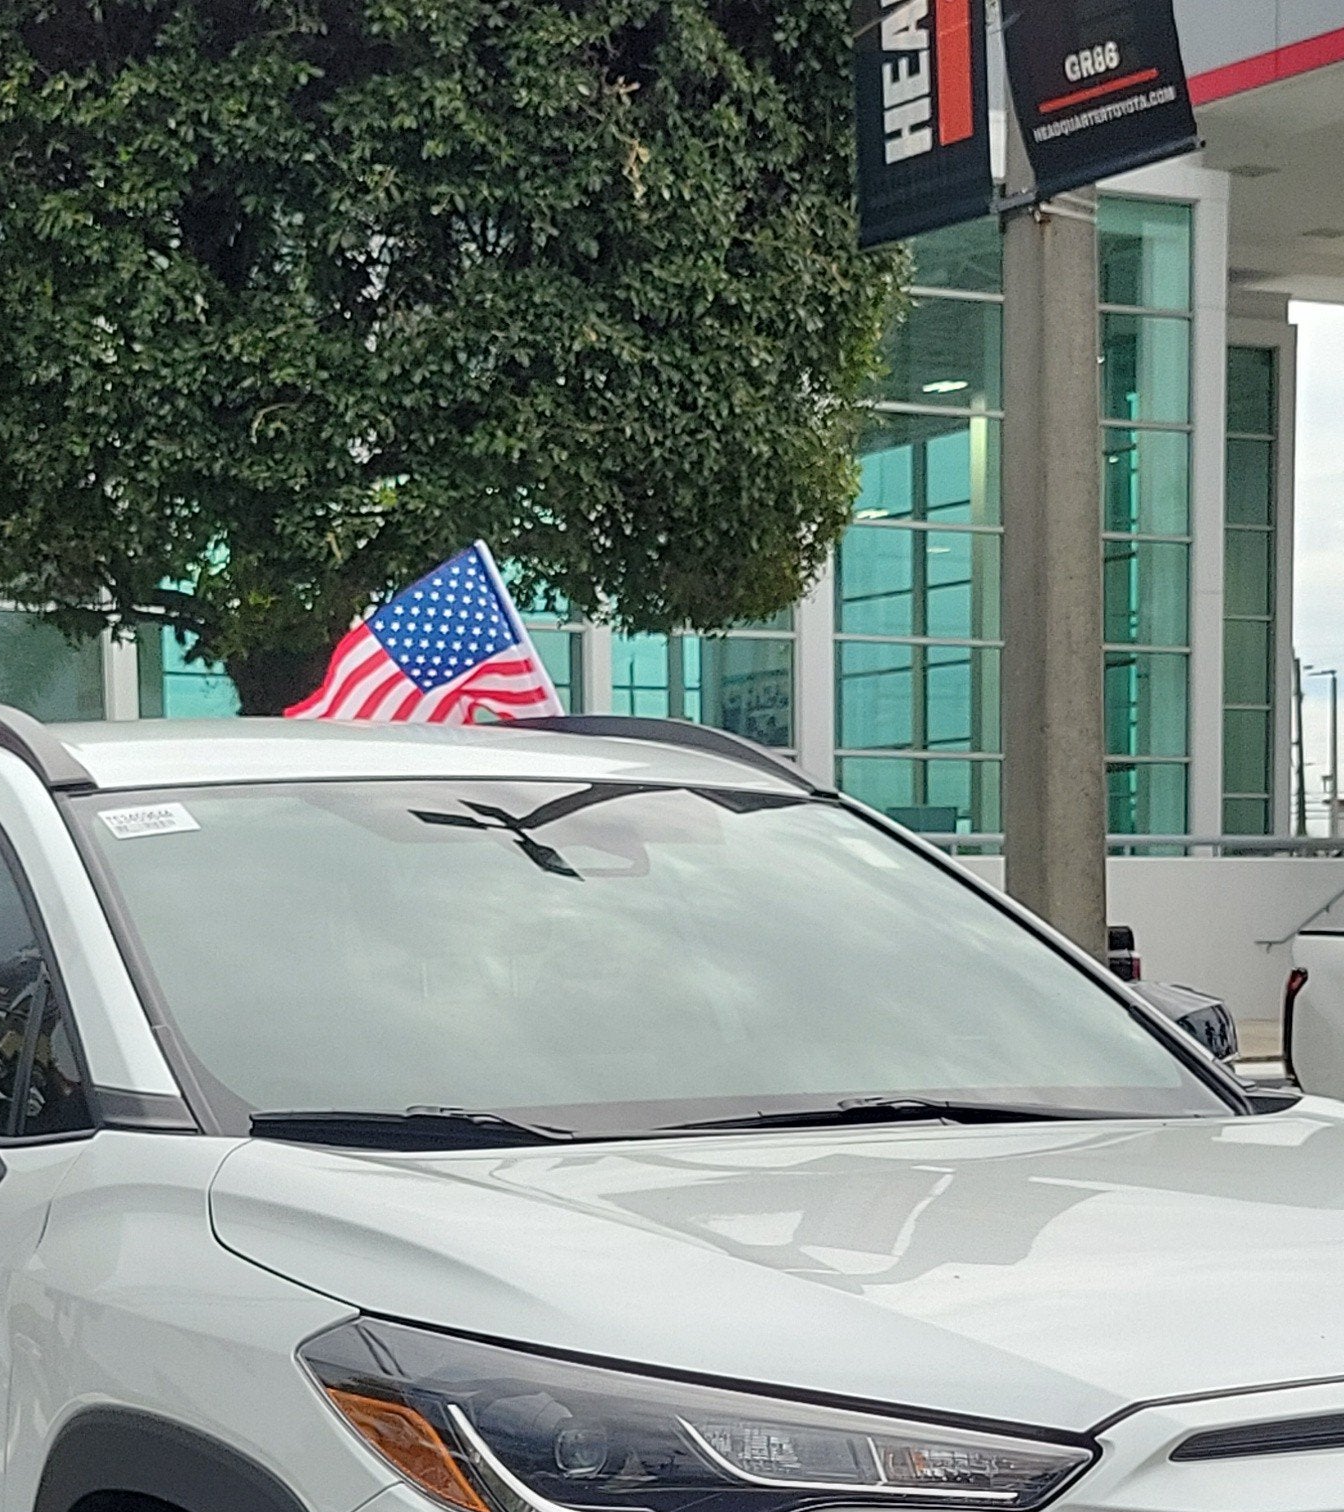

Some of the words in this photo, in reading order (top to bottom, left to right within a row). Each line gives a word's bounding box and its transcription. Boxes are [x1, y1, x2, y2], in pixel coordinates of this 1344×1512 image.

[881, 0, 933, 165] HEA
[1064, 40, 1121, 82] GR86
[1033, 85, 1176, 143] HEADQUARTERTOYOTA.COM
